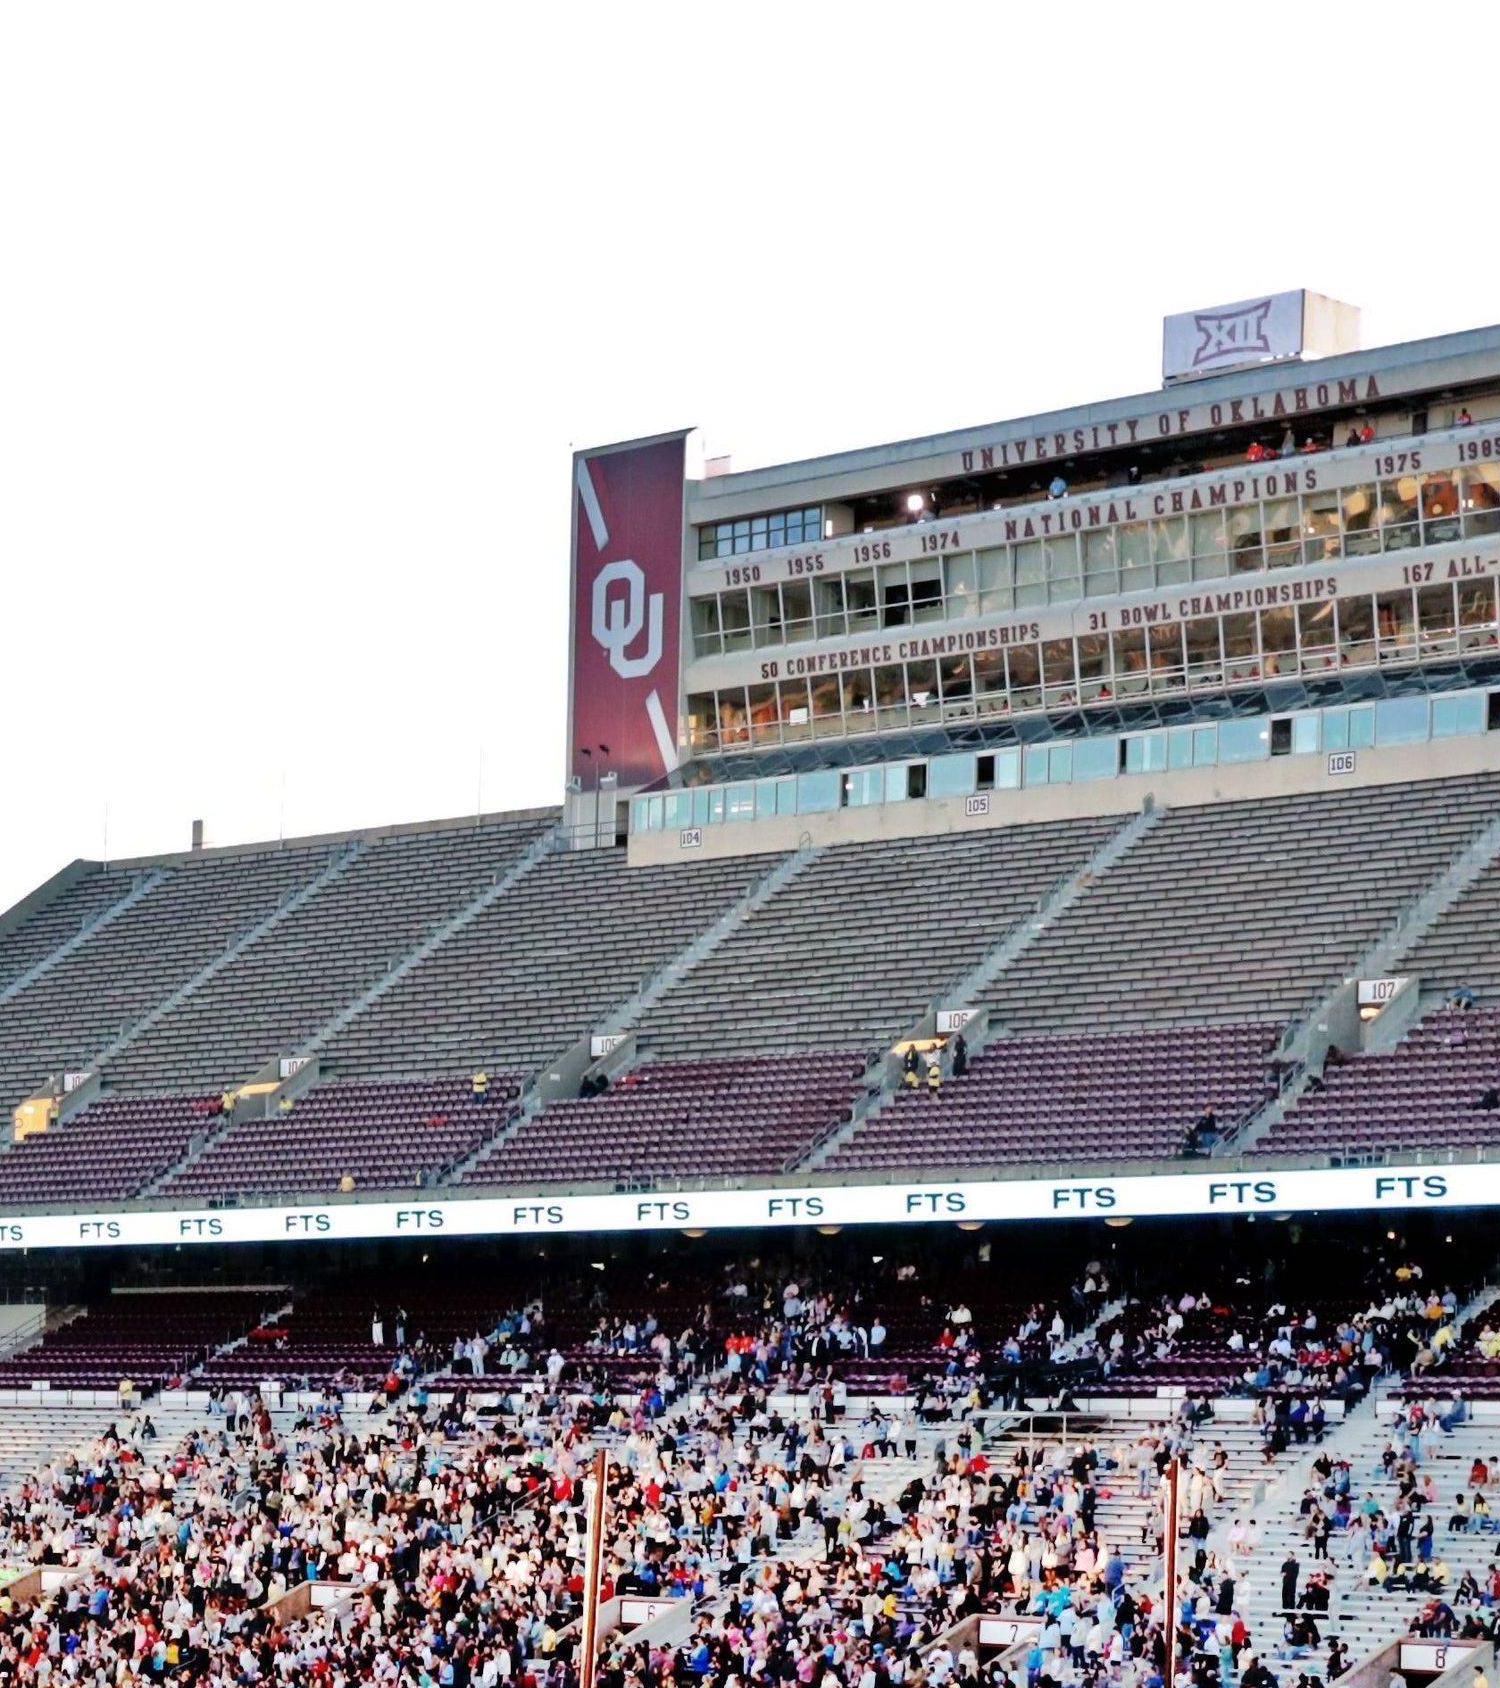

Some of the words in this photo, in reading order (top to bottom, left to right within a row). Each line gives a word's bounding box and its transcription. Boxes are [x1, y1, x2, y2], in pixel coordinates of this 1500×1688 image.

[962, 419, 1139, 472] UNIVERSITY
[1158, 409, 1191, 436] OF
[1210, 375, 1381, 426] OKLAHOMA
[1375, 452, 1422, 476] 1975
[1005, 500, 1137, 540] NATIONAL
[1154, 468, 1318, 515] CHAMPIONS
[921, 530, 959, 553] 1974
[853, 542, 891, 564] 1956
[725, 565, 761, 586] 1950
[787, 554, 824, 576] 1955
[1402, 562, 1434, 584] 167
[1089, 612, 1107, 631] 31
[1121, 603, 1171, 626] BOWL
[1179, 577, 1337, 617] CHAMPIONSHIPS
[592, 559, 664, 679] OU
[761, 661, 778, 679] 50
[787, 645, 892, 676] CONFERENCE
[899, 623, 1040, 657] CHAMPIONSHIPS
[1331, 755, 1353, 770] 106
[968, 797, 987, 812] 105
[681, 832, 700, 845] 104
[1372, 980, 1396, 999] 107
[1053, 1187, 1116, 1209] FTS
[1209, 1182, 1276, 1204] FTS
[1376, 1176, 1447, 1199] FTS
[638, 1202, 689, 1221] FTS
[769, 1197, 823, 1217] FTS
[907, 1193, 966, 1213] FTS
[286, 1214, 330, 1232] FTS
[396, 1210, 444, 1228] FTS
[514, 1206, 563, 1224] FTS
[80, 1222, 120, 1239] FTS
[180, 1219, 222, 1236] FTS
